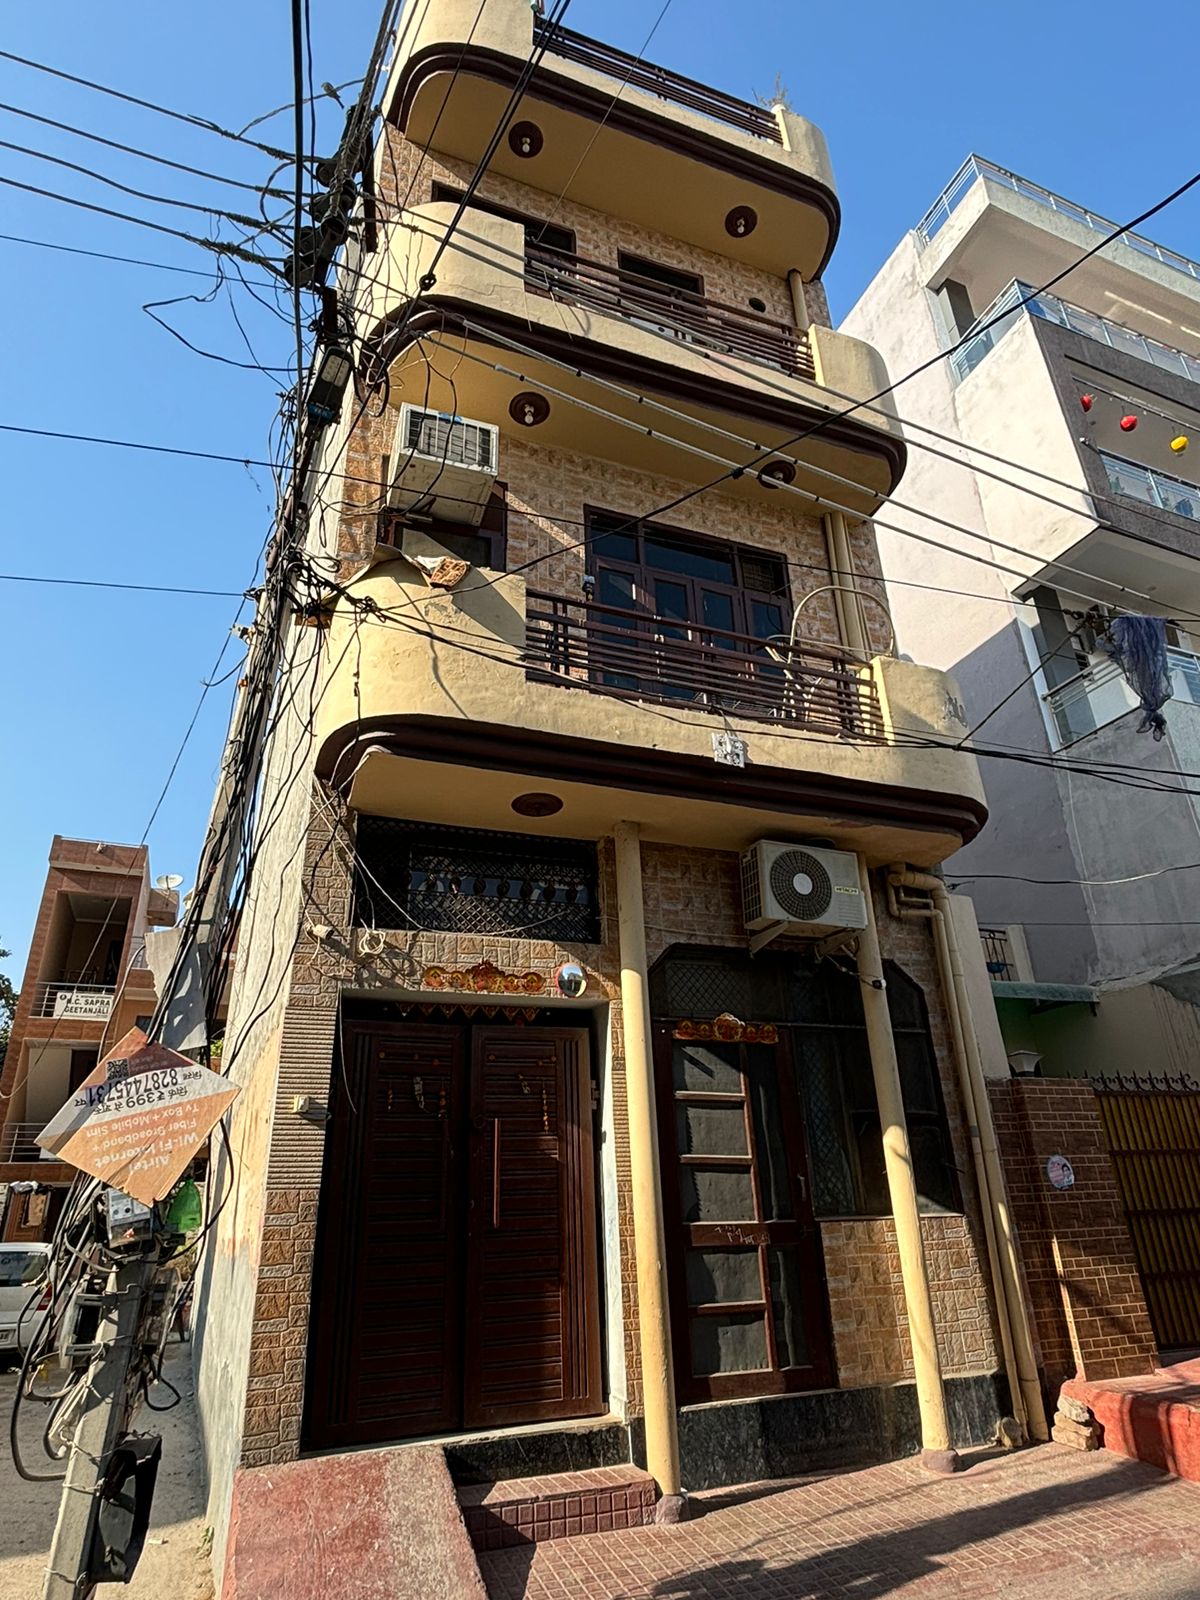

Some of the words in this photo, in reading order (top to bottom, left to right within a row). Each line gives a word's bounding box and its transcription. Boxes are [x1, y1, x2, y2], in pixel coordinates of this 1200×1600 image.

[64, 1006, 109, 1014] GEETANJALI
[88, 1068, 178, 1107] 8287445731
[167, 1086, 188, 1099] सिर्फ
[114, 1101, 124, 1112] से
[161, 1107, 183, 1118] Box
[185, 1103, 199, 1113] Tv
[111, 1116, 150, 1131] Mobile
[168, 1118, 197, 1131] Fiber
[86, 1126, 108, 1138] Sim
[102, 1127, 166, 1151] Broadband
[159, 1132, 199, 1151] Wi-Fi
[128, 1154, 170, 1173] Airtel
